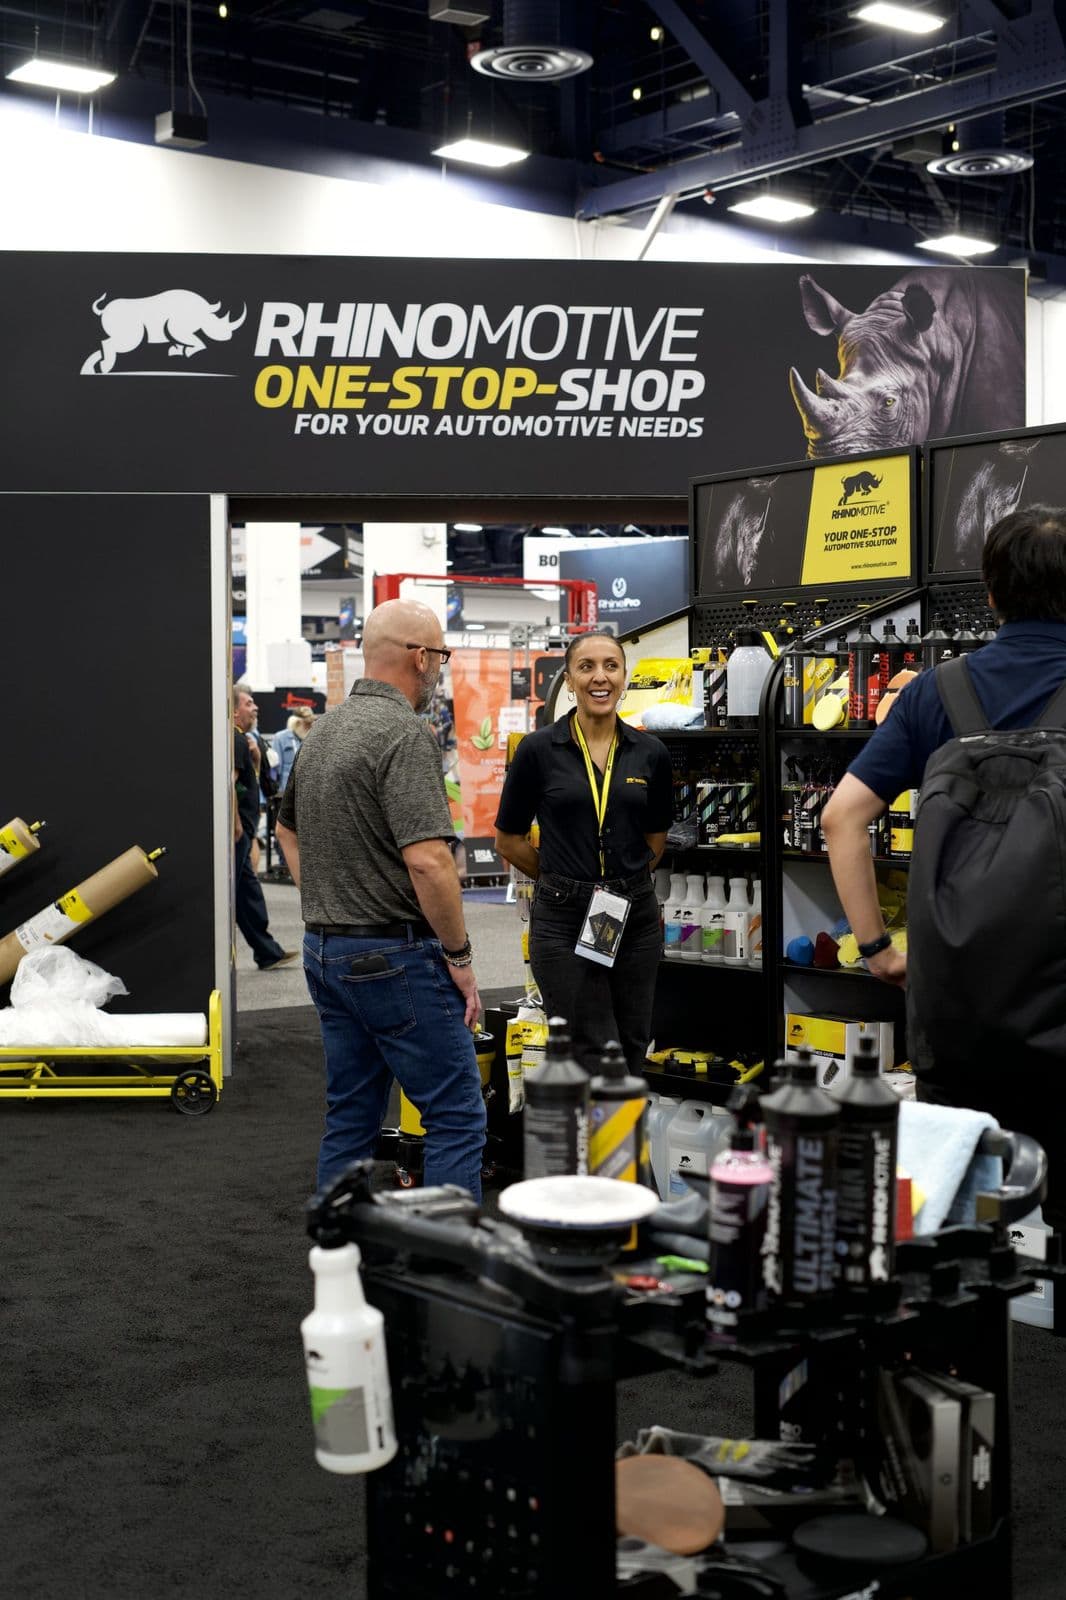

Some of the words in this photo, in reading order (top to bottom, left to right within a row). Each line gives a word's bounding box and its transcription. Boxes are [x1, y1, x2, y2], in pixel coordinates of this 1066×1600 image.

[254, 302, 705, 362] RHINOMOTIVE
[254, 365, 706, 413] ONE-STOP-SHOP
[294, 413, 347, 436] FOR
[357, 415, 428, 437] YOUR
[434, 415, 612, 438] AUTOMOTIVE
[618, 417, 705, 439] NEEDS
[824, 531, 848, 542] YOUR
[850, 526, 897, 539] ONE-STOP
[824, 541, 864, 552] AUTOMOTIVE
[865, 538, 897, 548] SOLUTION
[794, 1137, 824, 1293] ULTIMATE
